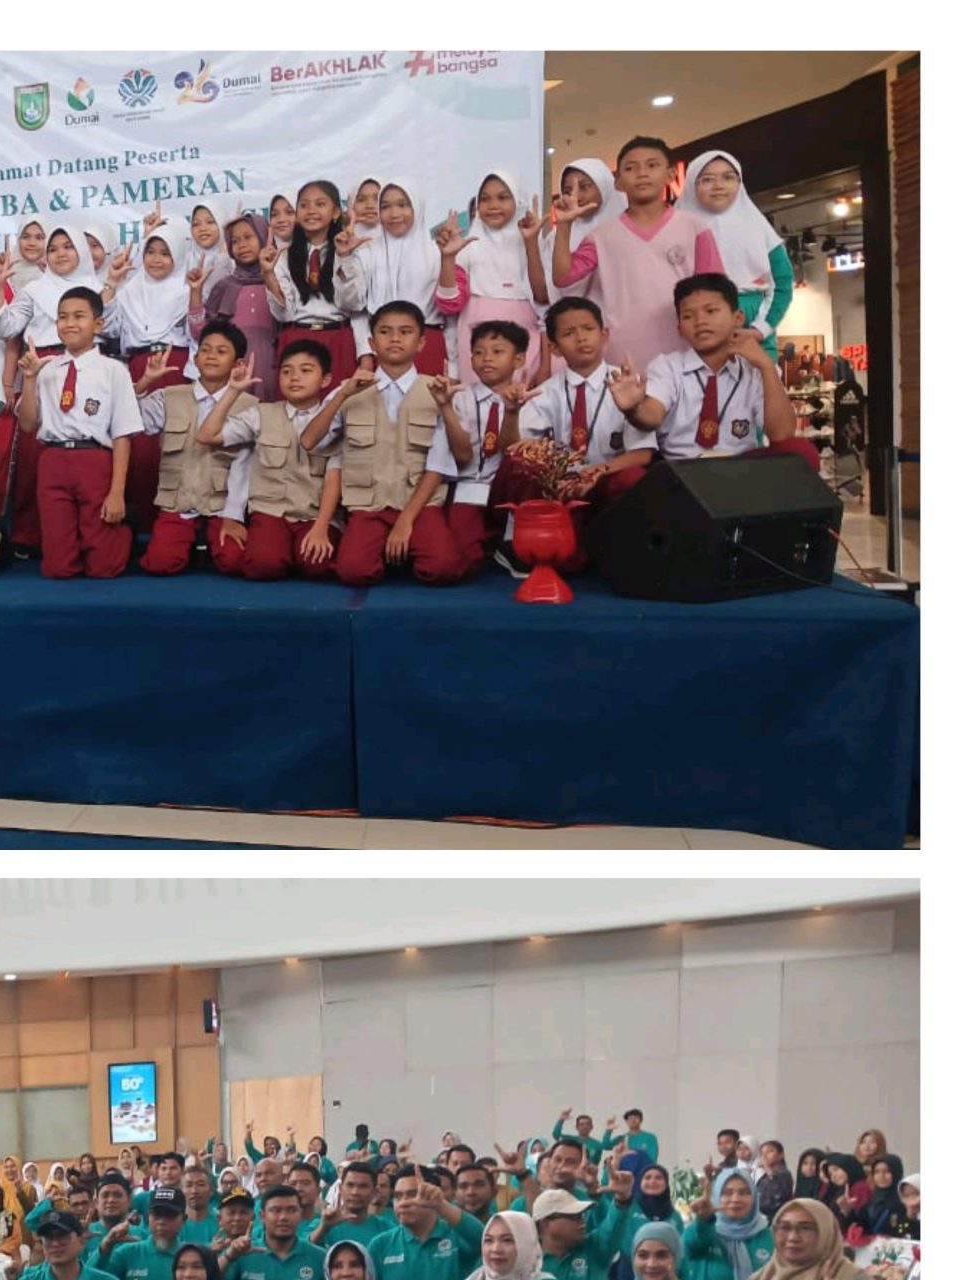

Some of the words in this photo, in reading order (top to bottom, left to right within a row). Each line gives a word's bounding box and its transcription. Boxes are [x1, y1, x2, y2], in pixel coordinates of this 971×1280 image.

[270, 53, 386, 83] BerAKHLAK
[438, 57, 498, 75] bangsa
[223, 73, 261, 88] Dumai
[65, 112, 100, 126] Dumai
[48, 154, 118, 177] Datang
[125, 145, 200, 166] Peserta
[49, 187, 71, 212] &
[80, 167, 246, 208] PAMERAN
